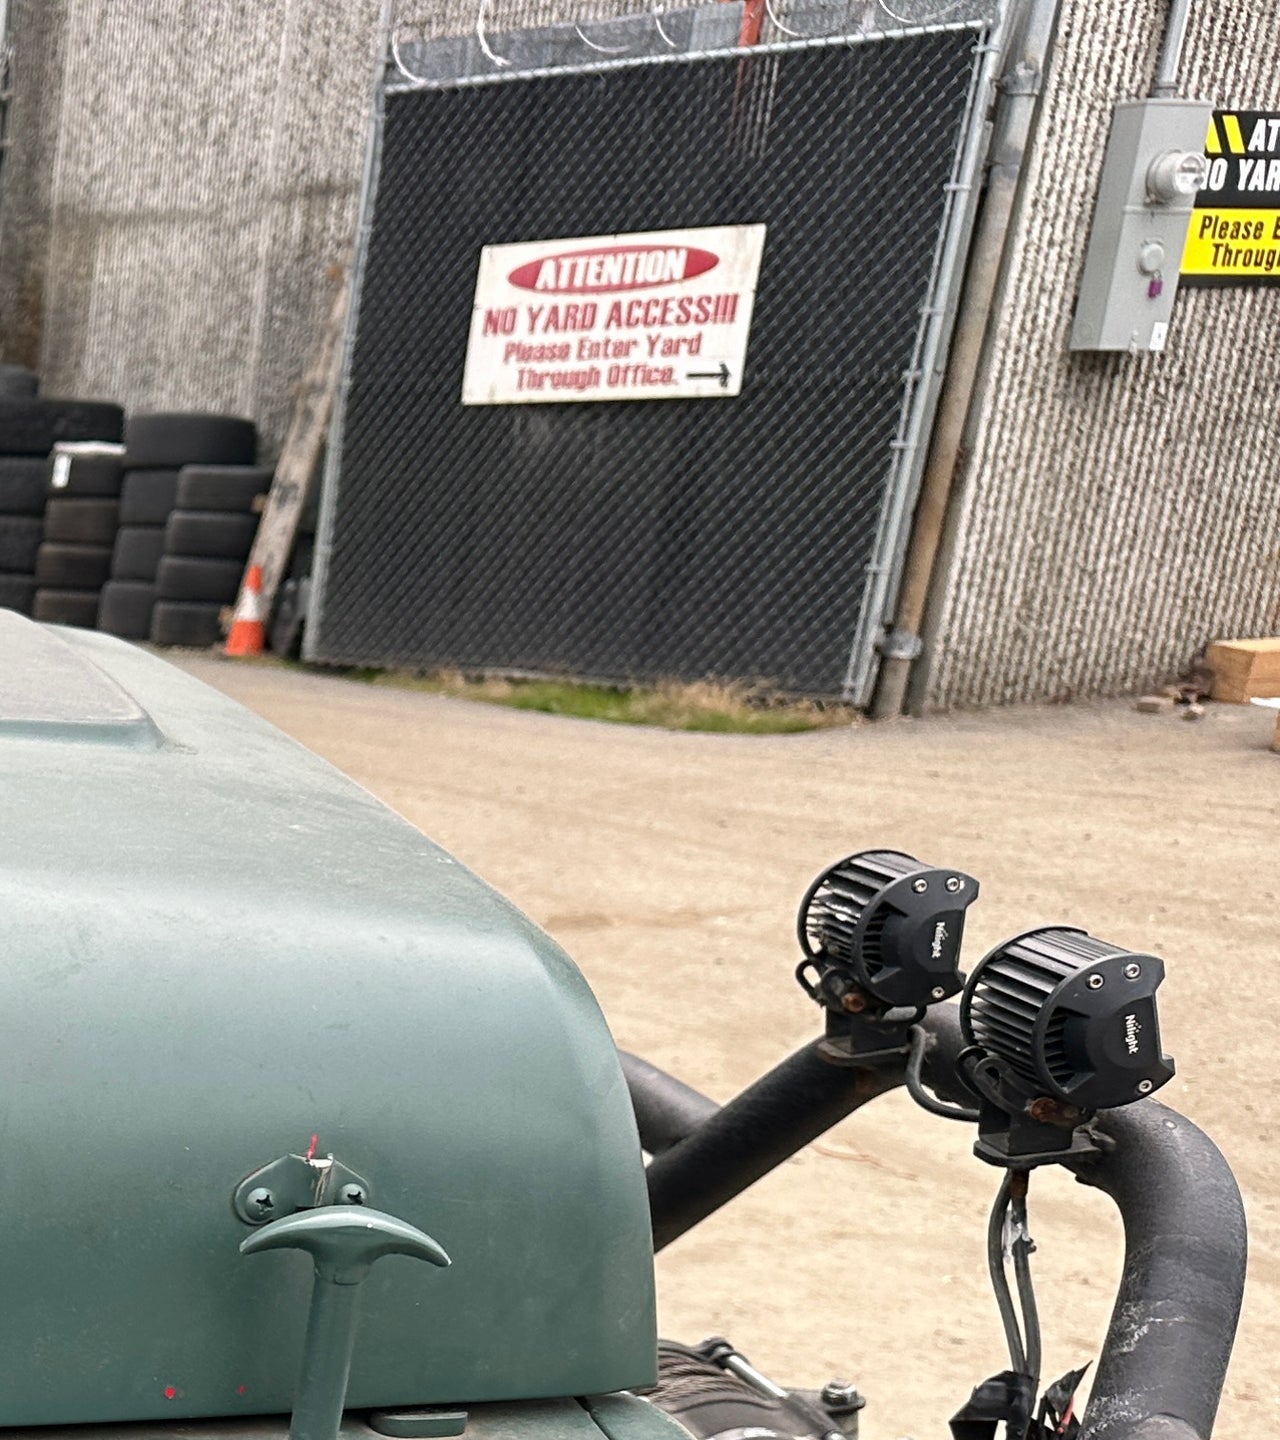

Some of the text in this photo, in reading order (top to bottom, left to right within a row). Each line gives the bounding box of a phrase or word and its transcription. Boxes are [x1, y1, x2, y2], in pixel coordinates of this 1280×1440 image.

[1199, 215, 1264, 241] Please
[534, 248, 688, 290] ATTENTION
[1212, 242, 1280, 272] Throug
[482, 307, 517, 337] NO
[526, 302, 598, 335] YARD
[502, 331, 703, 365] Please Enter Yard
[515, 365, 601, 393] Through
[1125, 1014, 1142, 1054] Nilight
